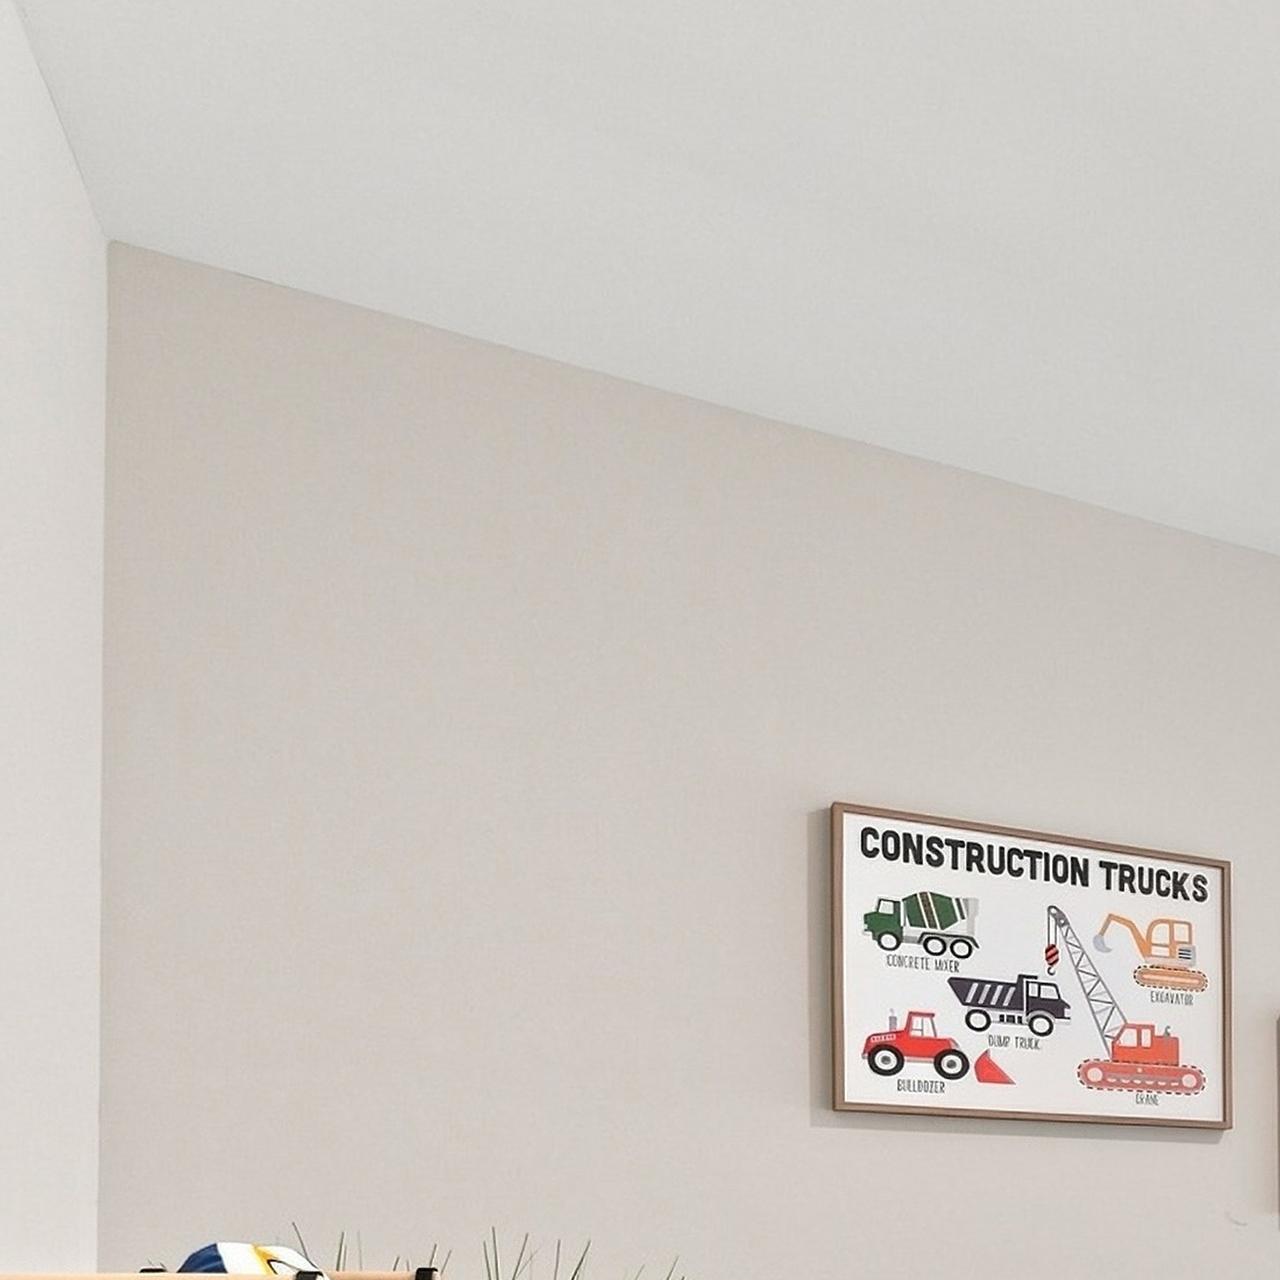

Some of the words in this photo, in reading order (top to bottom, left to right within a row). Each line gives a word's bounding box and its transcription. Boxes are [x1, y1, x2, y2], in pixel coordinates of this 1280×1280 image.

[860, 827, 1089, 887] CONSTRUCTION
[1099, 860, 1209, 902] TRUCKS
[886, 954, 930, 971] CONCRETE
[934, 959, 960, 973] MIXER
[1150, 990, 1194, 1006] EXCAVATOR
[988, 1034, 1011, 1048] DUMP
[1014, 1036, 1041, 1050] TRUCK
[896, 1078, 946, 1094] BULLDOZER
